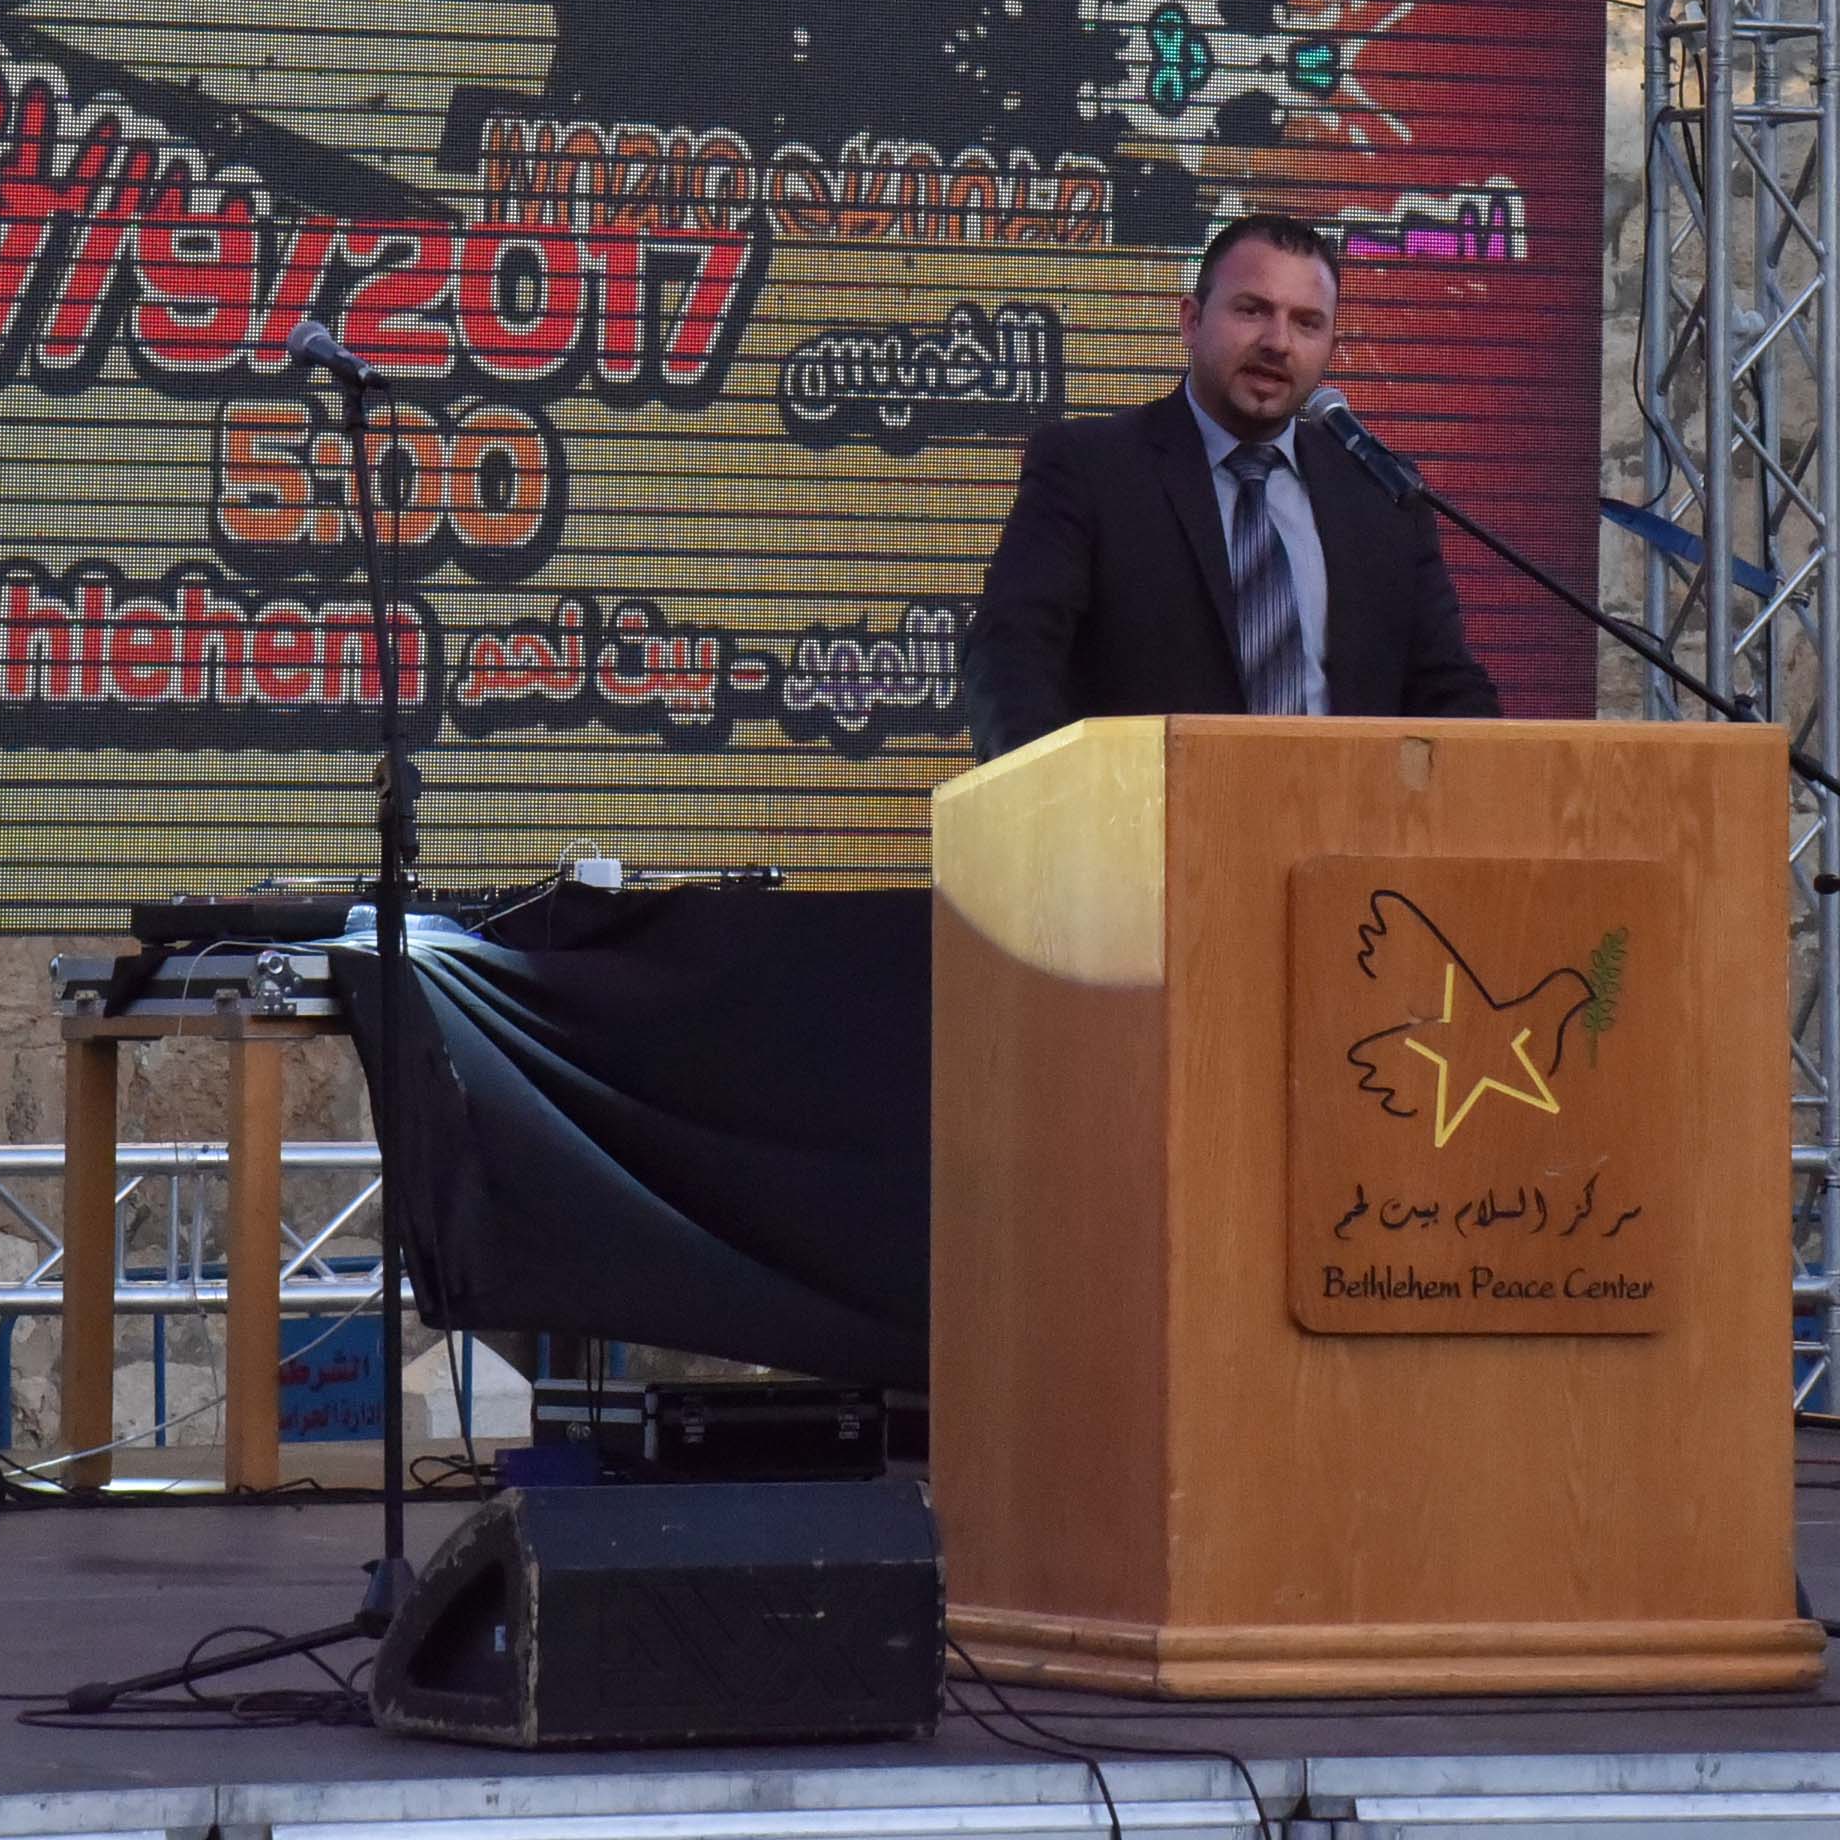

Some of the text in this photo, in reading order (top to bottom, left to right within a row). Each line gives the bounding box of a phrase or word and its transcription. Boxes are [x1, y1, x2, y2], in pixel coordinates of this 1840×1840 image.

[785, 306, 1049, 424] الخميس
[216, 398, 550, 550] 5:00
[459, 598, 585, 705] لحم
[598, 599, 718, 723] بيت
[785, 609, 956, 729] المهد
[1334, 1183, 1370, 1240] لحم
[1380, 1196, 1440, 1229] بيت
[1455, 1185, 1547, 1238] السلام
[1322, 1264, 1656, 1300] Bethlehem Peace Center
